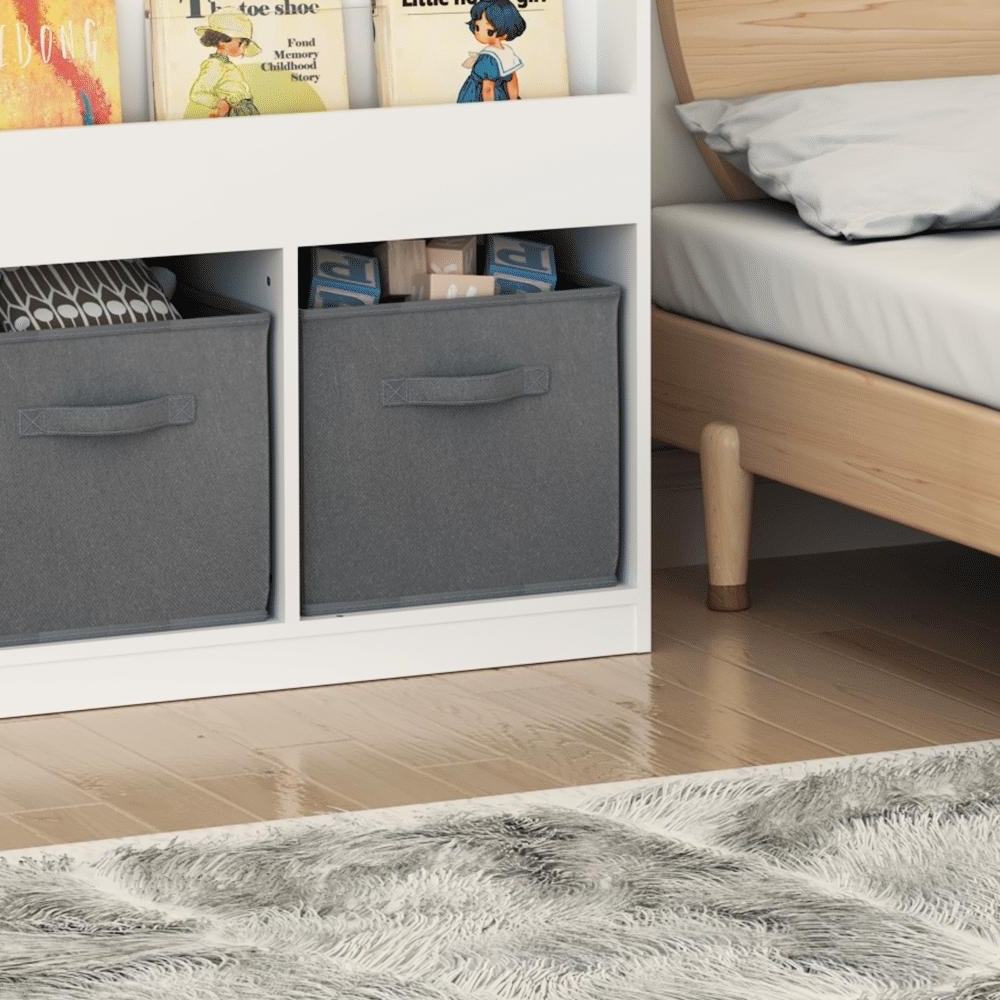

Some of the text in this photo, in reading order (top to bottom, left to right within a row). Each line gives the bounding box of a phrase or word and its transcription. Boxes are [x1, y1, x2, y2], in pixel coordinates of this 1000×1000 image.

[239, 1, 270, 16] toe
[274, 0, 320, 16] shoe
[287, 38, 316, 48] Fond
[274, 50, 320, 60] Memory
[261, 59, 317, 72] Childhood
[291, 73, 320, 83] Story
